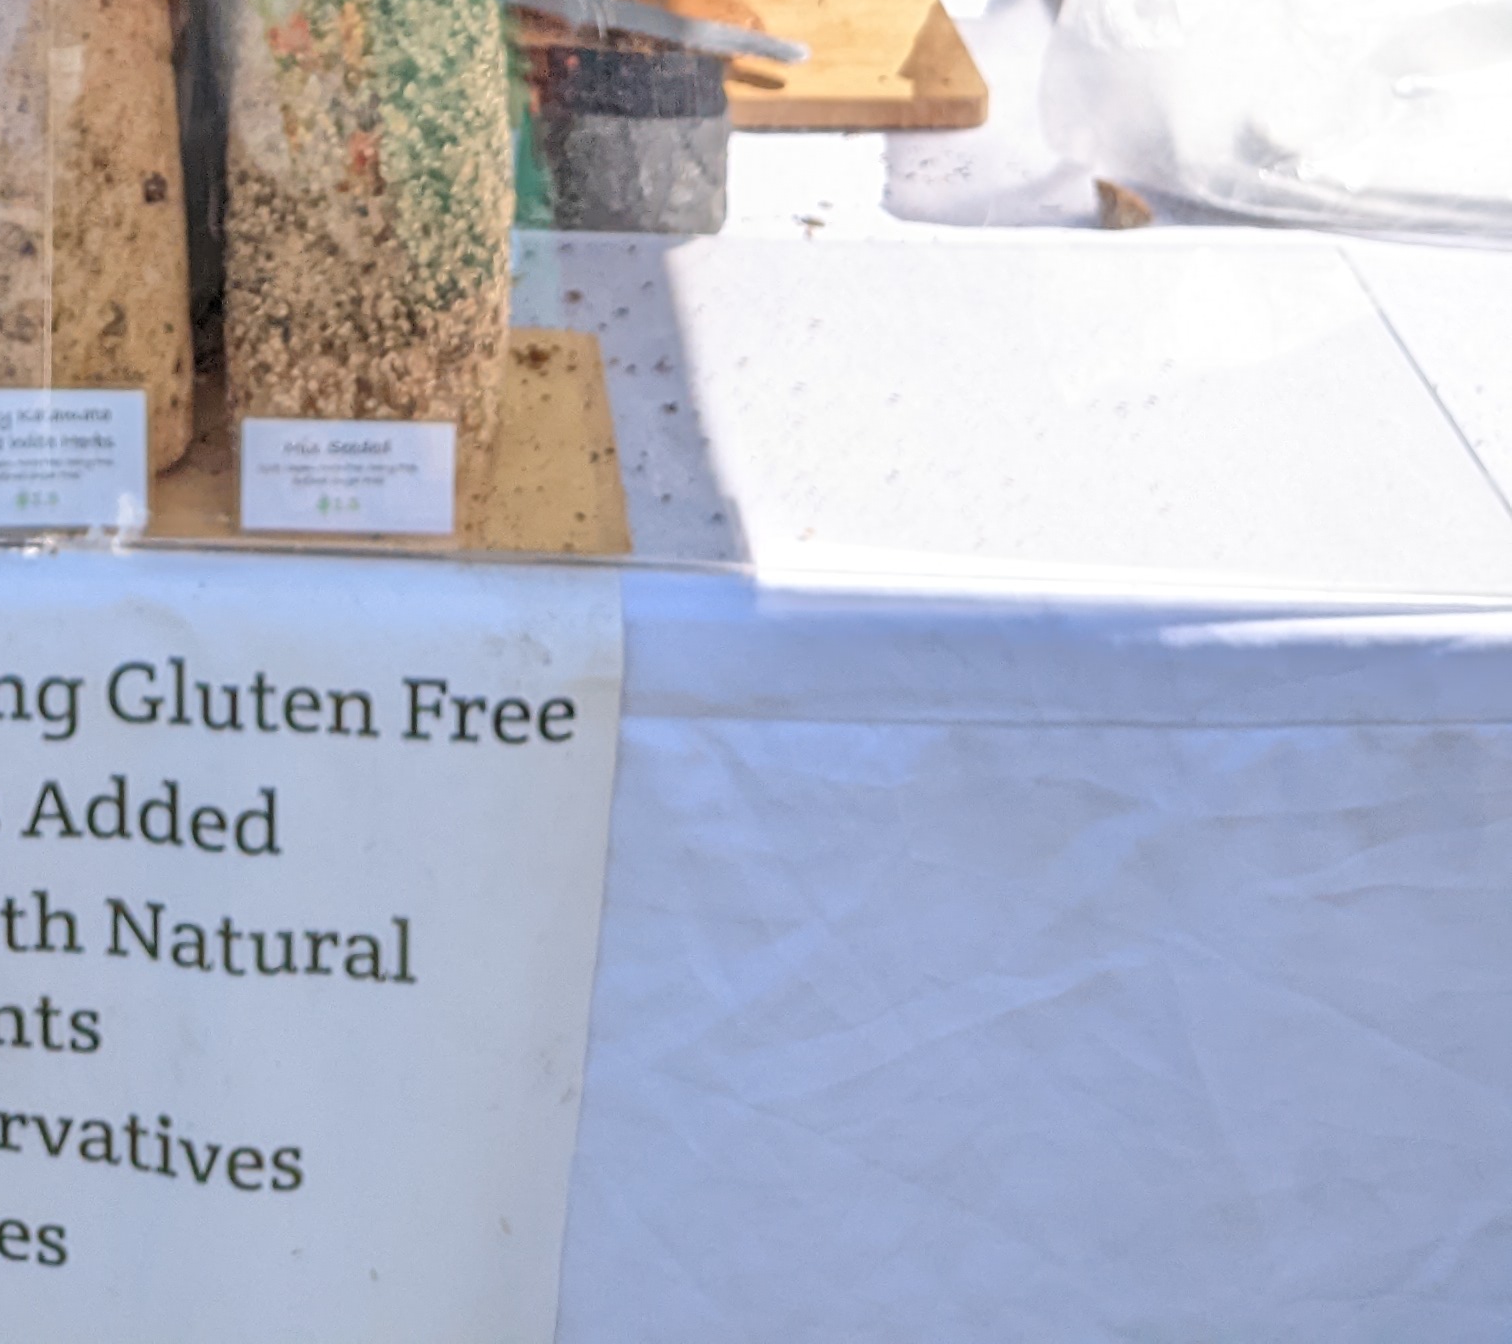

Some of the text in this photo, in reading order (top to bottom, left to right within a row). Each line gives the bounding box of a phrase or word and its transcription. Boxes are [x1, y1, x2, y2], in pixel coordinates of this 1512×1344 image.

[106, 661, 380, 739] Gluten
[400, 676, 577, 746] Free
[20, 774, 283, 857] Added
[103, 897, 418, 985] Natural
